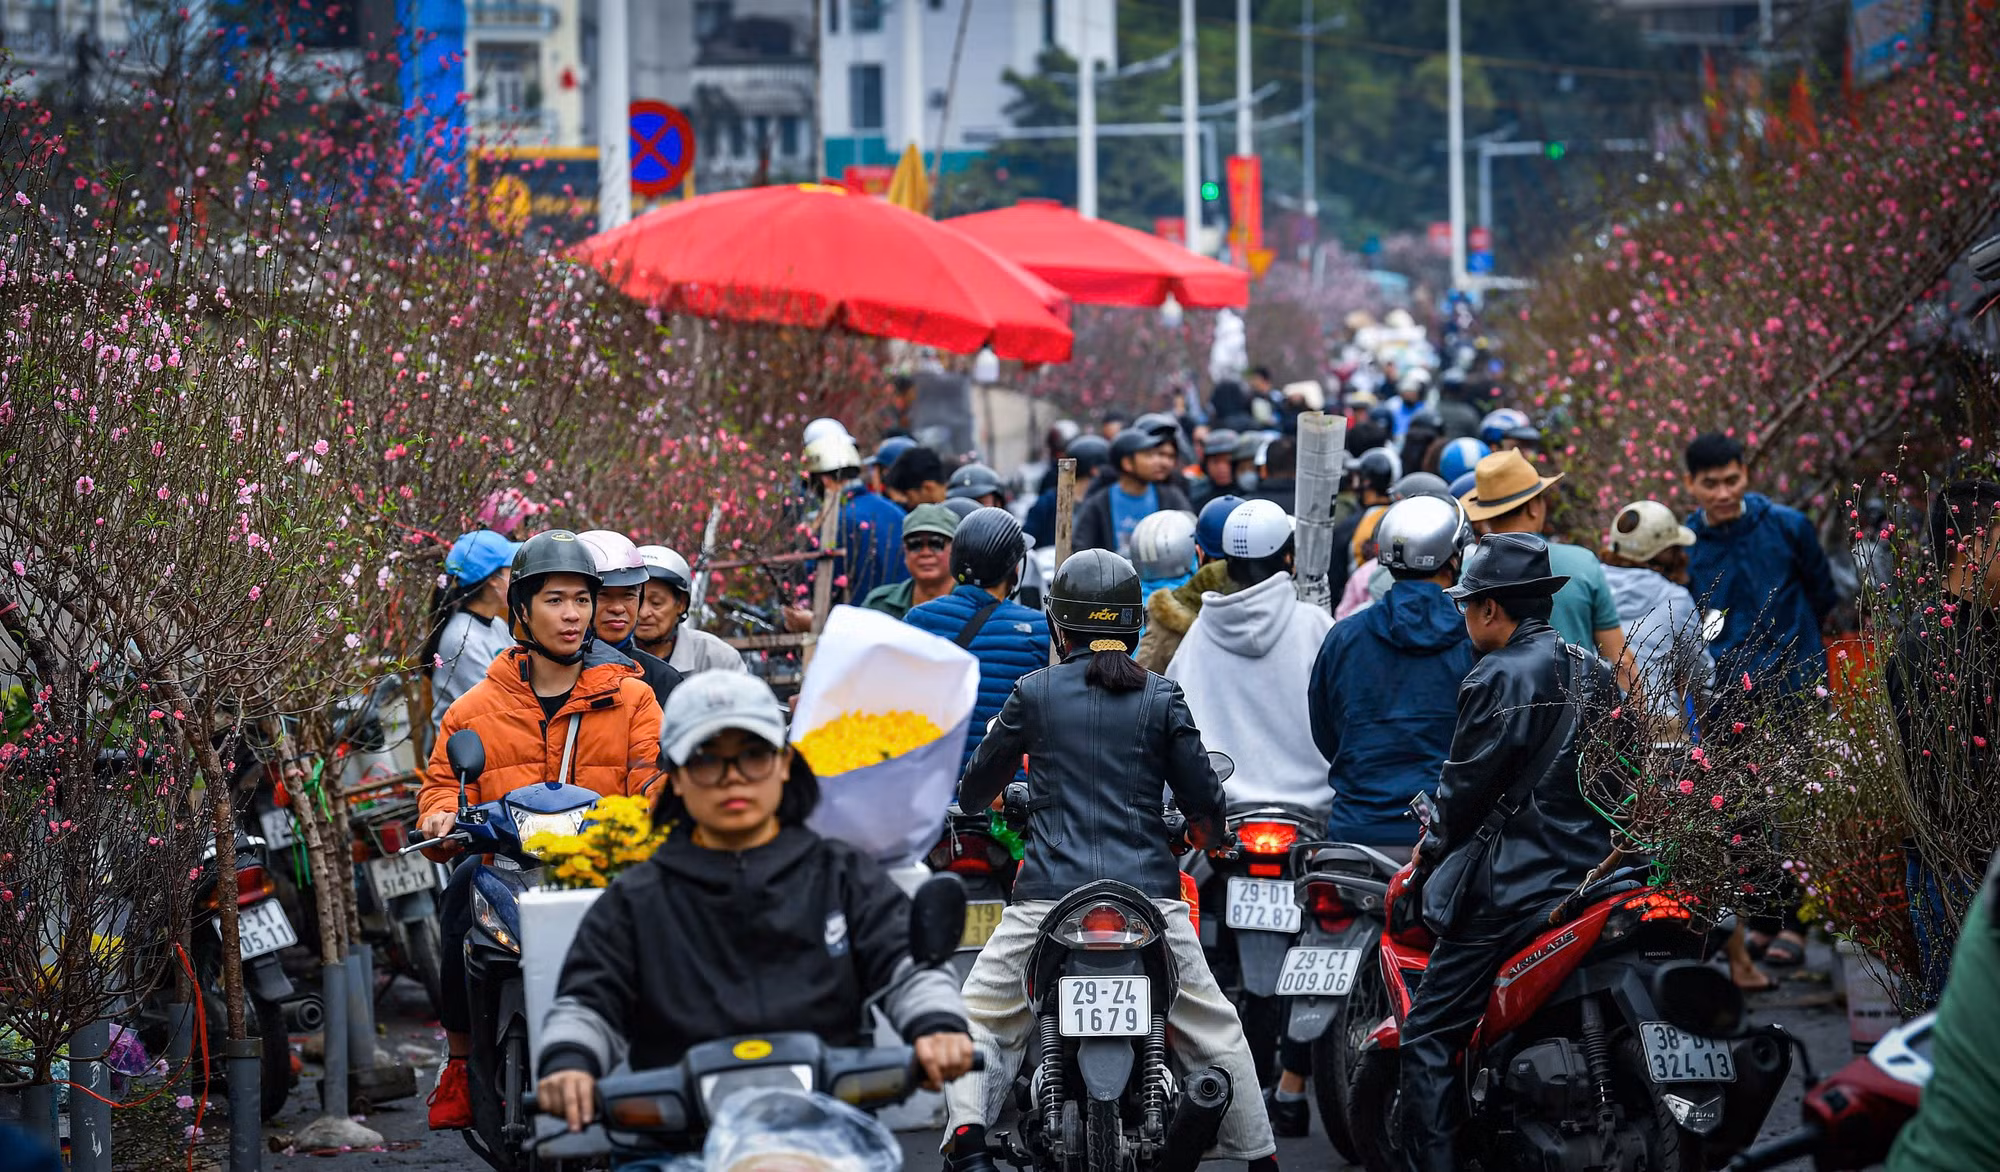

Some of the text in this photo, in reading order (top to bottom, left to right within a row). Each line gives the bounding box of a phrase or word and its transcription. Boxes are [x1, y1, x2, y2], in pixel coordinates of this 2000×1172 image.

[1239, 883, 1289, 905] 29-D1
[1232, 905, 1295, 928] 872.87
[241, 924, 290, 953] 05.11
[1294, 951, 1349, 970] 29-C1
[1072, 980, 1137, 1005] 29-Z4
[1282, 973, 1348, 991] 009.06
[1074, 1007, 1137, 1032] 1679
[1653, 1052, 1730, 1078] 324.13
